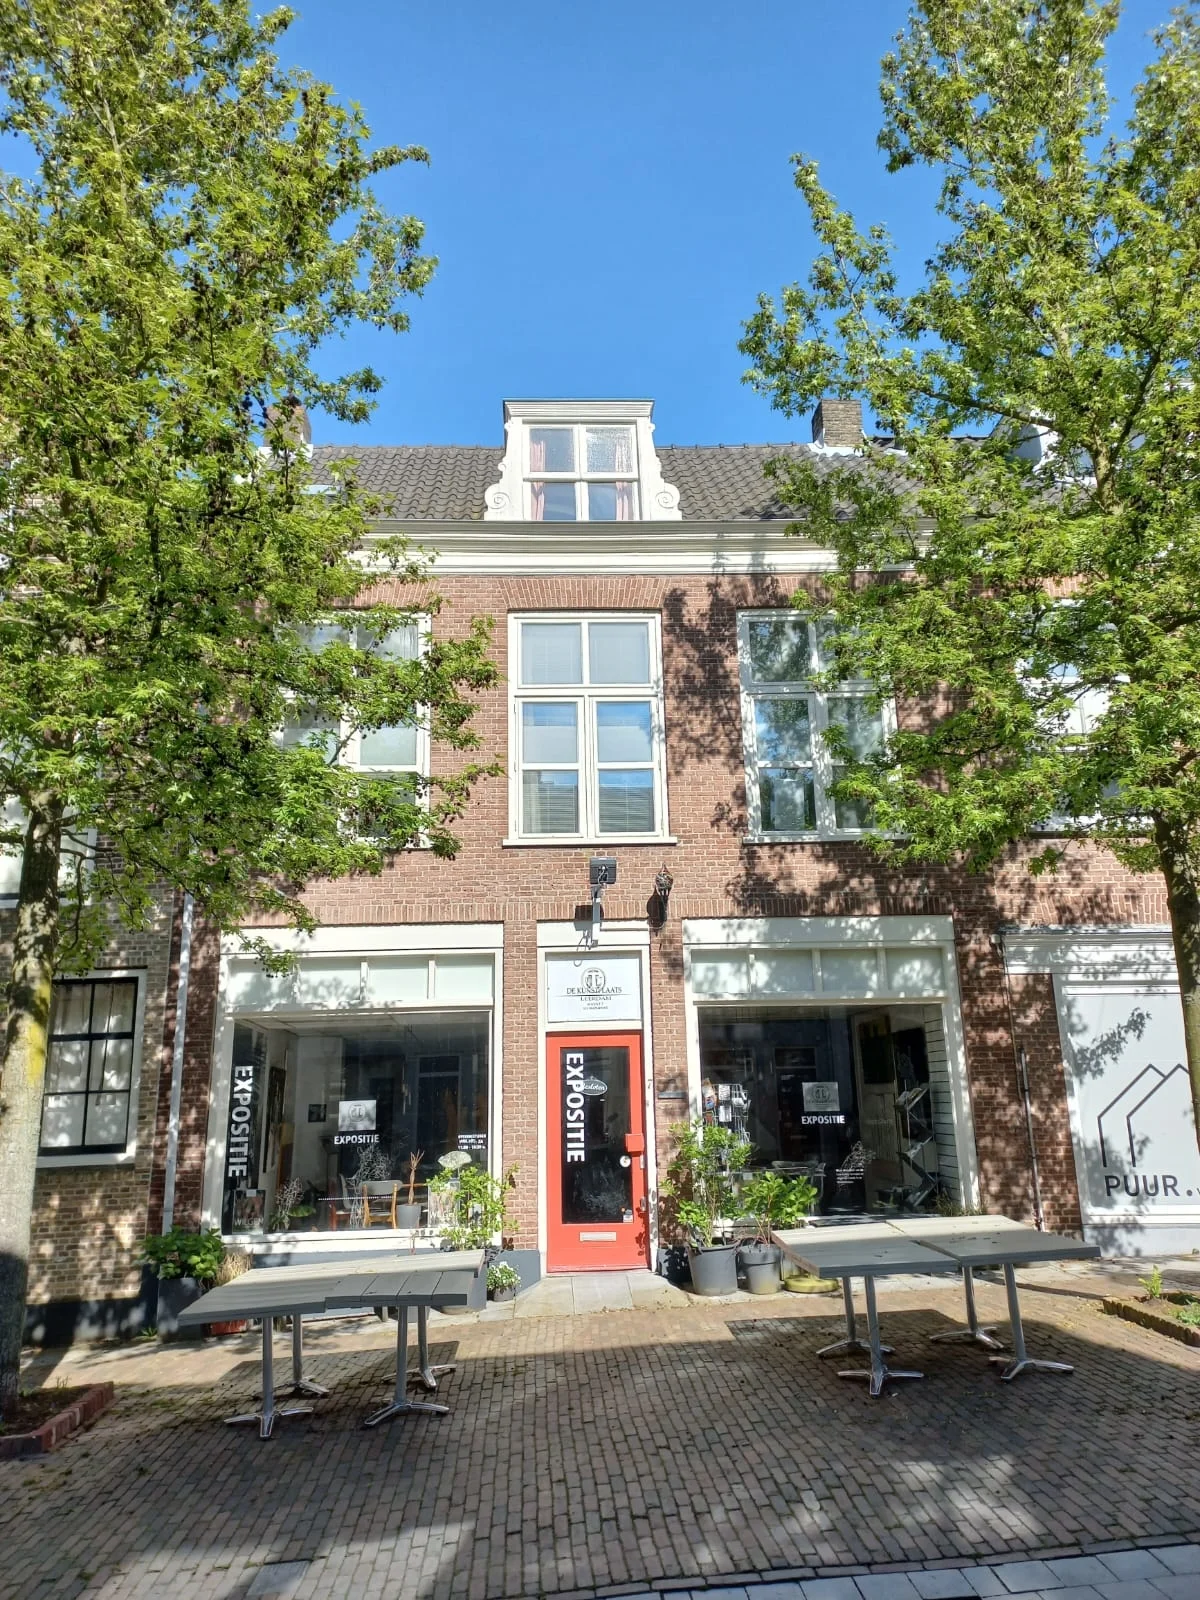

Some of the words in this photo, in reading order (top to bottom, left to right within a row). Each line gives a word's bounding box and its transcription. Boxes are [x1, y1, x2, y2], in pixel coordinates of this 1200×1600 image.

[228, 1065, 254, 1178] EXPOSITIE
[566, 1053, 585, 1163] EXPOSITIE
[801, 1114, 846, 1125] EXPOSITIE
[334, 1134, 380, 1145] EXPOSITIE
